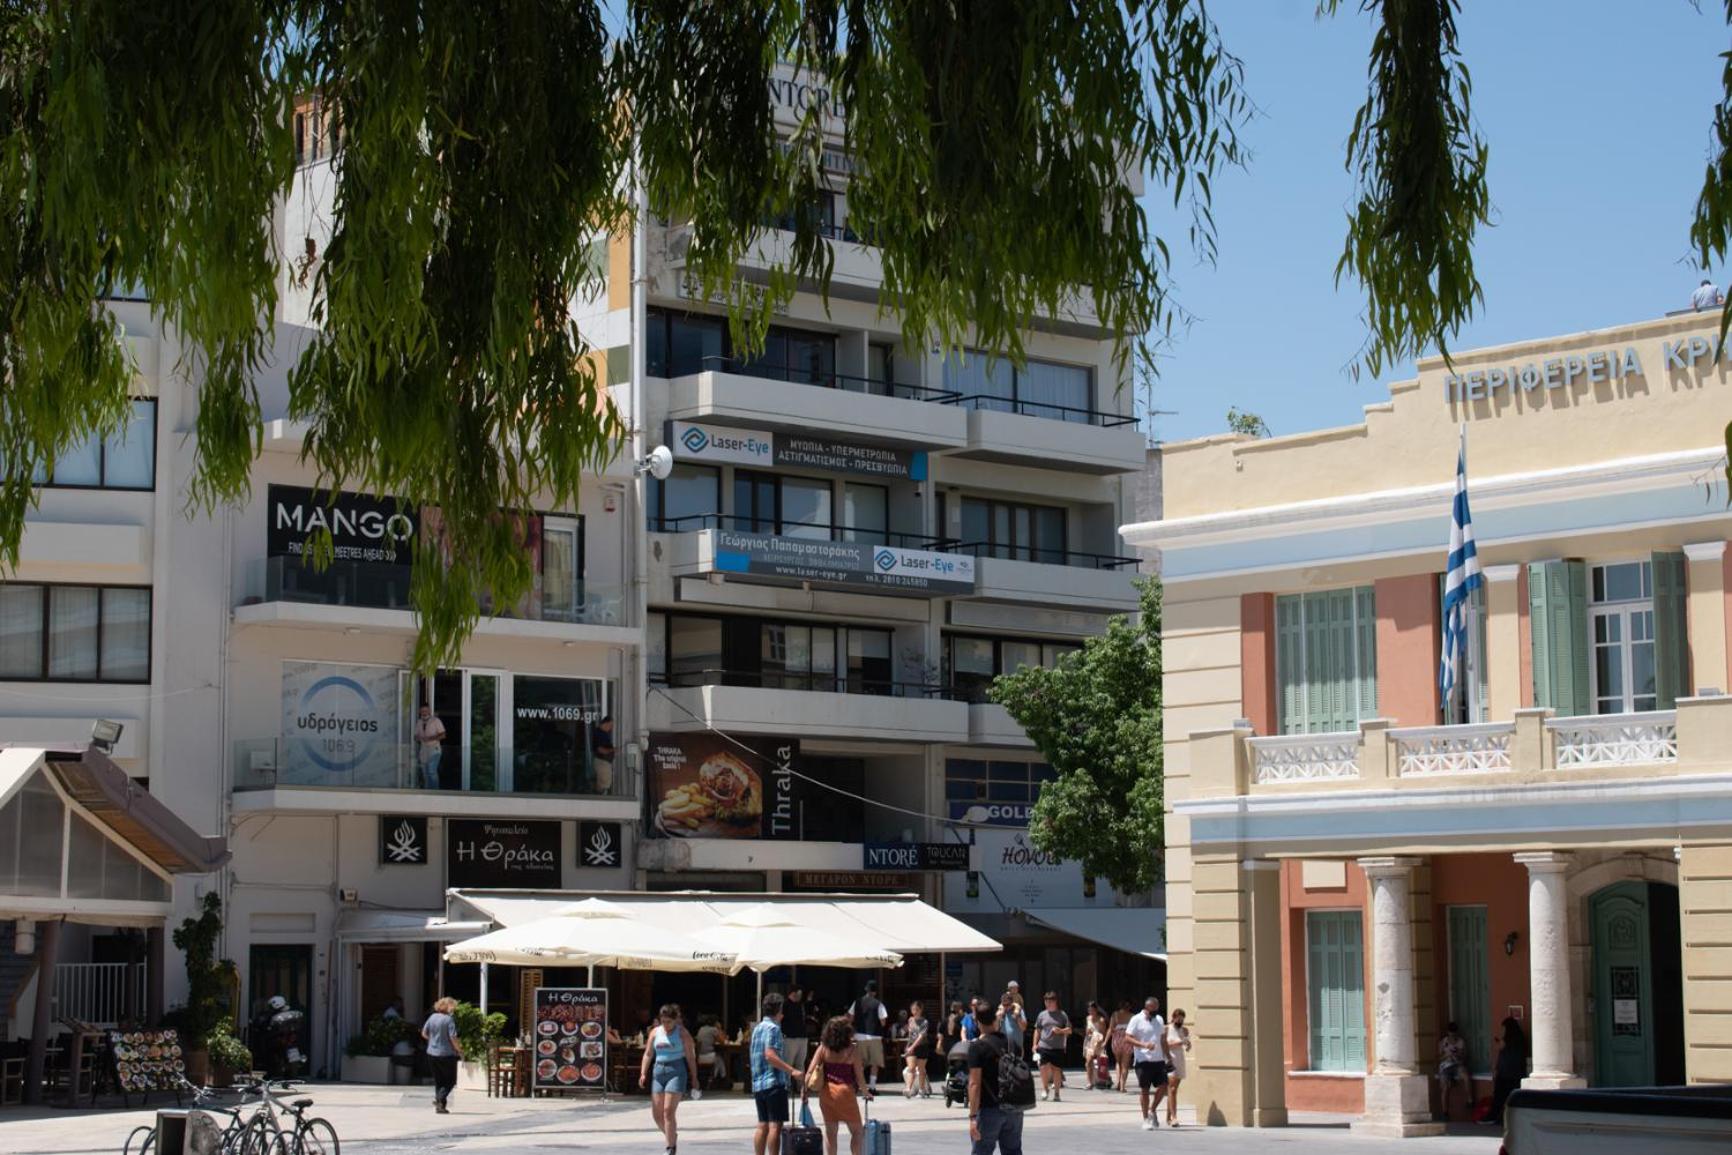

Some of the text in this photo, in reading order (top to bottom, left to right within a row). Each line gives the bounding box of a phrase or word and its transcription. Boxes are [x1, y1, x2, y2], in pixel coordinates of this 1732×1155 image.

[1444, 347, 1643, 403] ΠΕΡΙΦΕΡΕΙΑ
[711, 433, 769, 456] Laser-Eye
[276, 502, 413, 541] MANGO
[720, 533, 860, 560] Γεώργιος Παπαμαστοράκης
[901, 555, 954, 574] Laser-Eye
[297, 712, 379, 735] υδρόγειος
[517, 706, 600, 724] www.1069.gr
[771, 745, 791, 835] Thraka
[480, 840, 554, 870] Θράκα
[868, 845, 919, 868] NTORÉ
